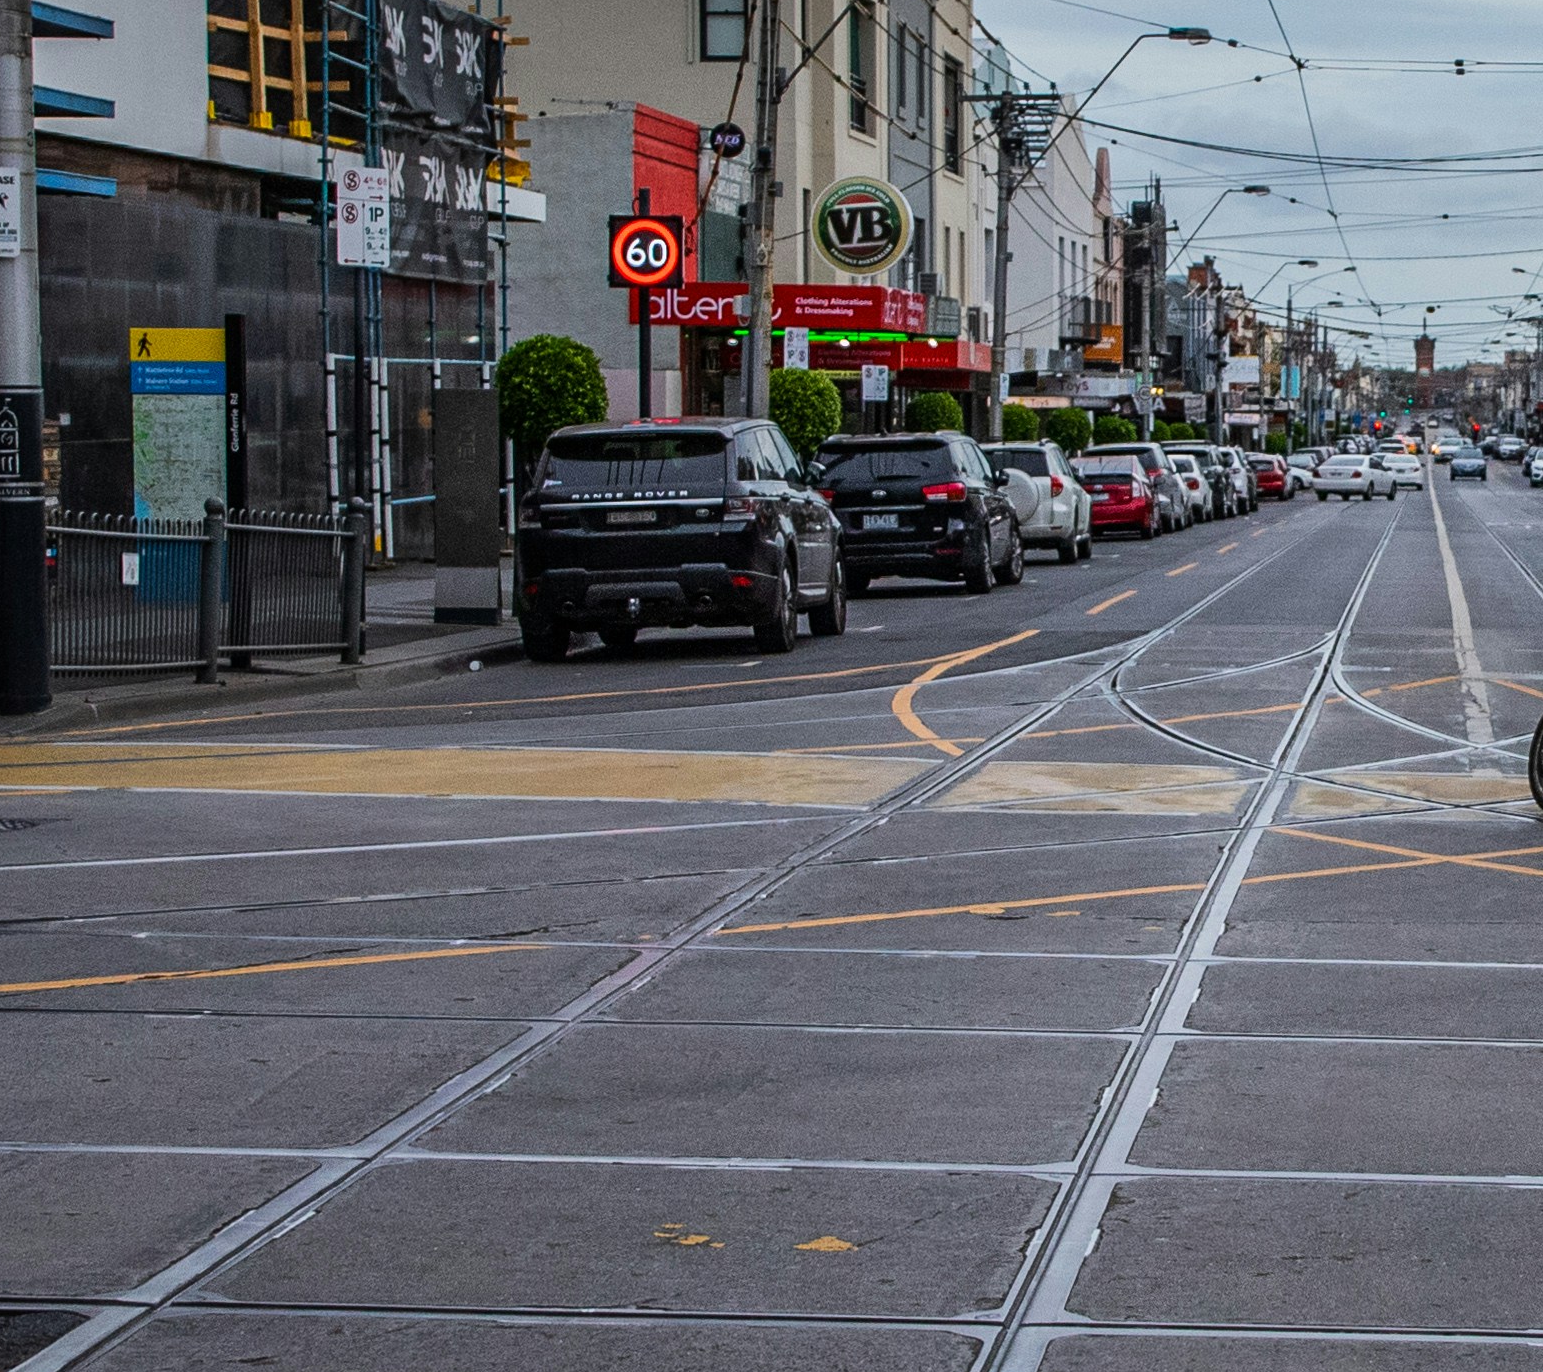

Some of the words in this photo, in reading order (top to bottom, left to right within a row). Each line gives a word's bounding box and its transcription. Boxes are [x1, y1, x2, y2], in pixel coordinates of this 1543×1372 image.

[828, 207, 894, 244] VB
[625, 237, 668, 269] 60
[795, 296, 828, 308] Clothing
[830, 297, 873, 307] Alterations
[804, 306, 854, 317] Dressmaking
[1058, 380, 1090, 392] Toys
[229, 392, 239, 405] Rd
[571, 492, 624, 501] RANGE
[633, 489, 689, 498] ROVER
